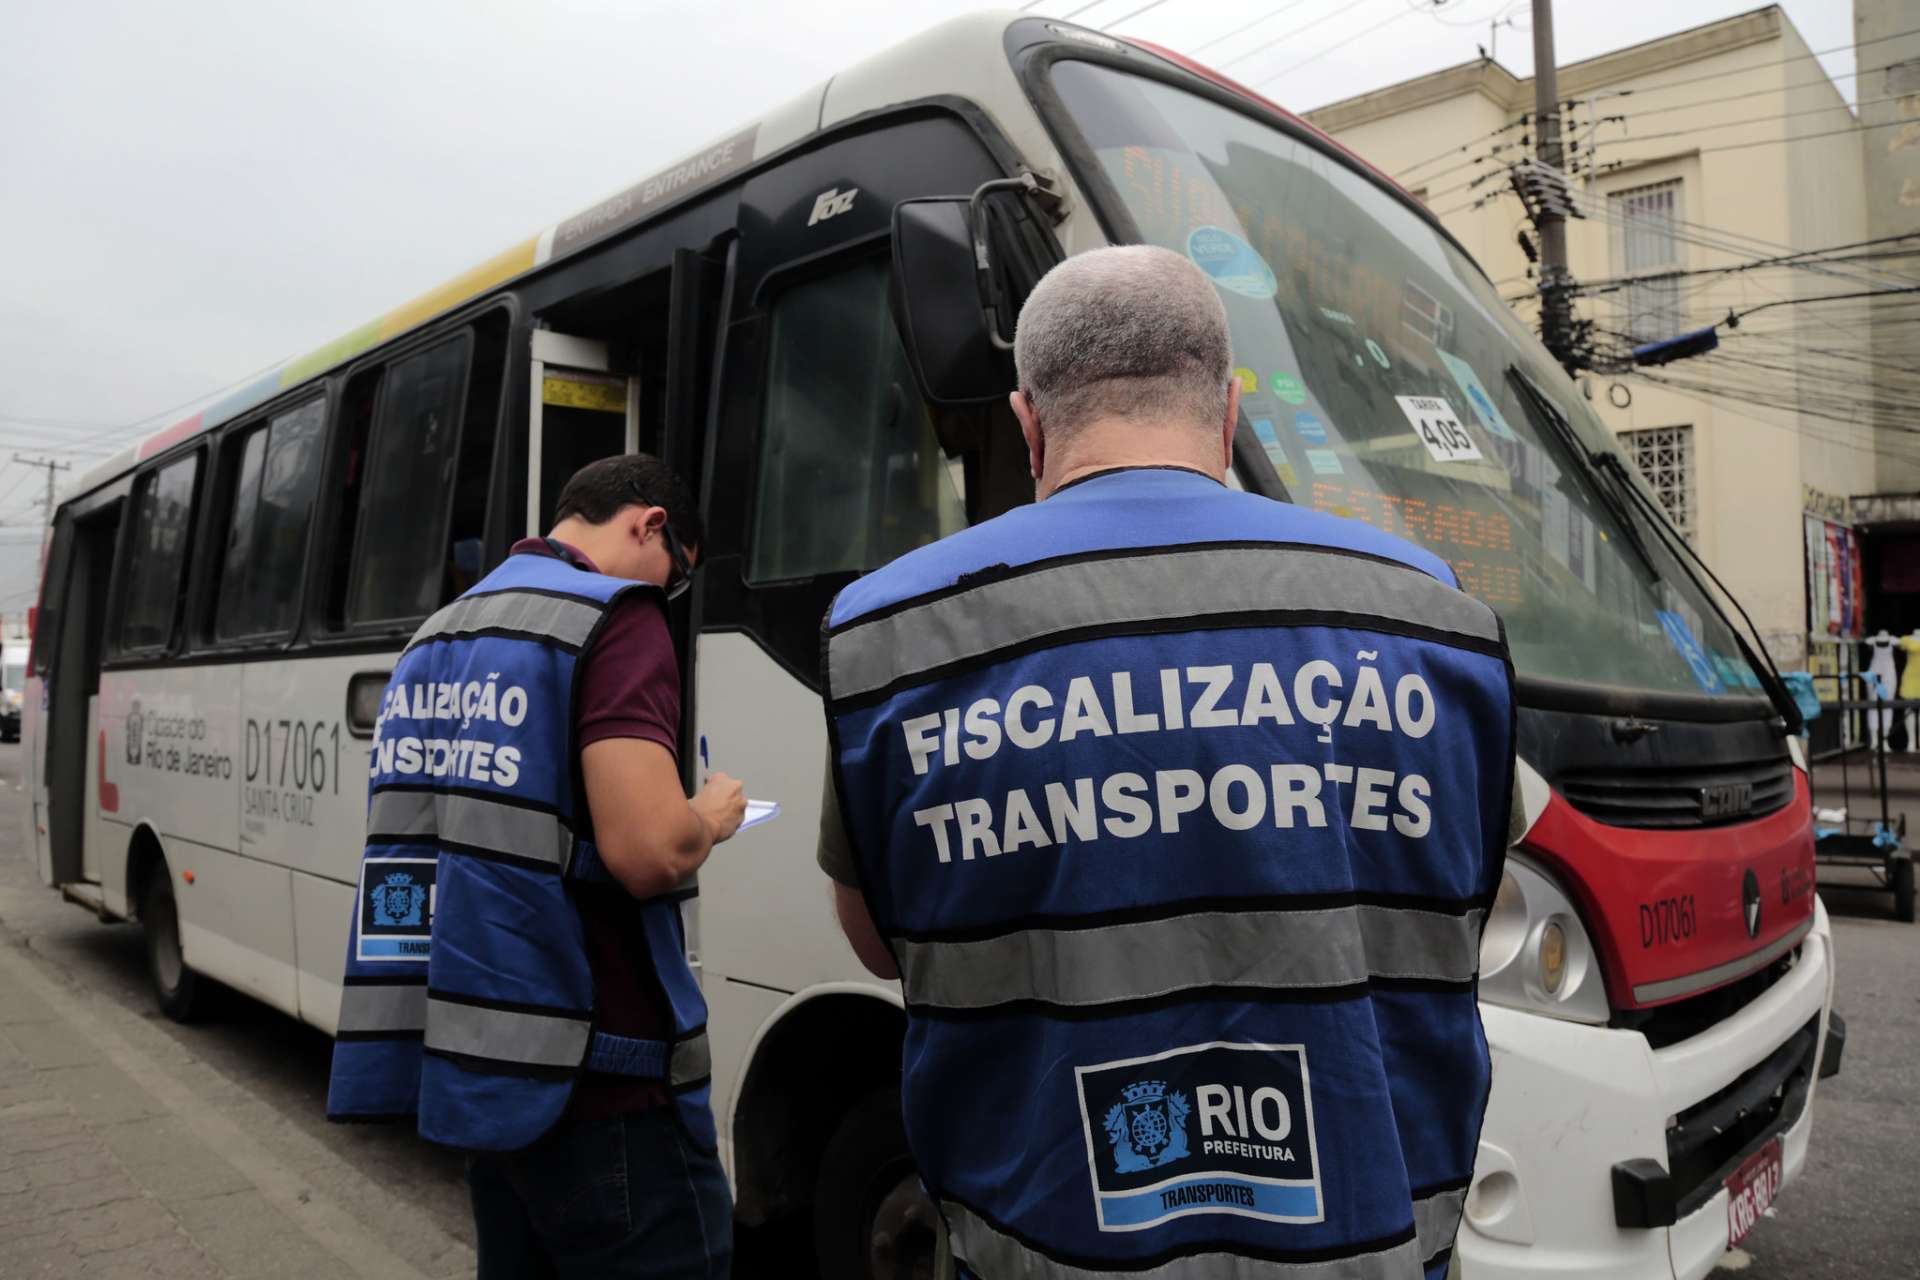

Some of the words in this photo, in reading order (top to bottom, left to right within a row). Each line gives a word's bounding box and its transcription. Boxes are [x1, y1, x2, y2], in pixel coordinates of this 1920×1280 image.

[641, 141, 734, 203] ENTRANCE
[1420, 417, 1471, 457] 4,05
[1312, 482, 1511, 550] ESTRADA
[381, 671, 528, 728] ALIZAÇÃO
[901, 650, 1436, 776] FISCALIZAÇÃO
[146, 741, 163, 771] Rio
[166, 744, 181, 772] de
[184, 746, 232, 780] Janeiro
[246, 718, 340, 796] D17061
[245, 786, 280, 820] SANTA
[281, 792, 315, 827] CRUZ
[913, 763, 1432, 864] TRANSPORTES
[1639, 894, 1697, 950] D17061
[1195, 1083, 1292, 1142] RIO
[1203, 1140, 1295, 1162] PREFEITURA
[1160, 1184, 1255, 1210] TRANSPORTES
